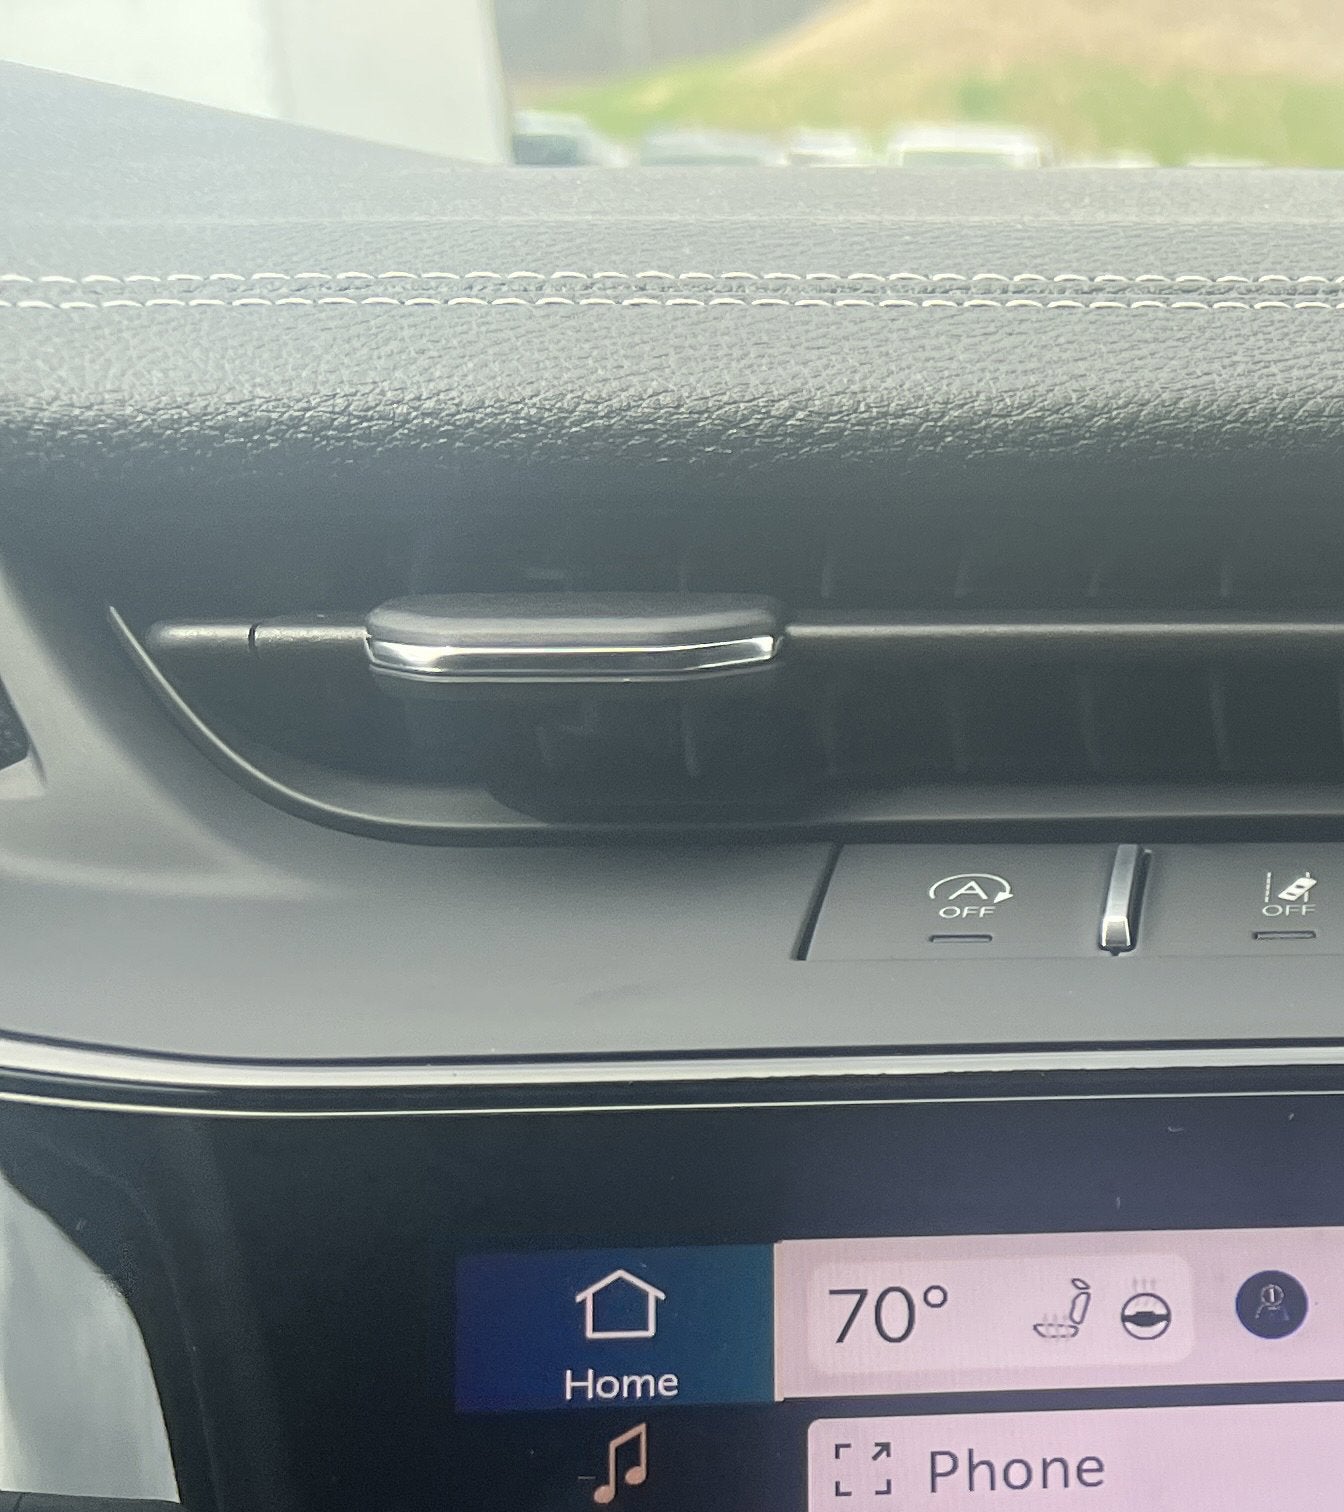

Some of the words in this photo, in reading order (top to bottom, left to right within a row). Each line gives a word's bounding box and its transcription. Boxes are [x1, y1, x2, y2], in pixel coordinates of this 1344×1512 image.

[939, 906, 996, 918] OFF
[1261, 904, 1316, 916] OFF
[828, 1285, 949, 1344] 70°
[565, 1370, 679, 1400] Home
[929, 1448, 1106, 1494] Phone
